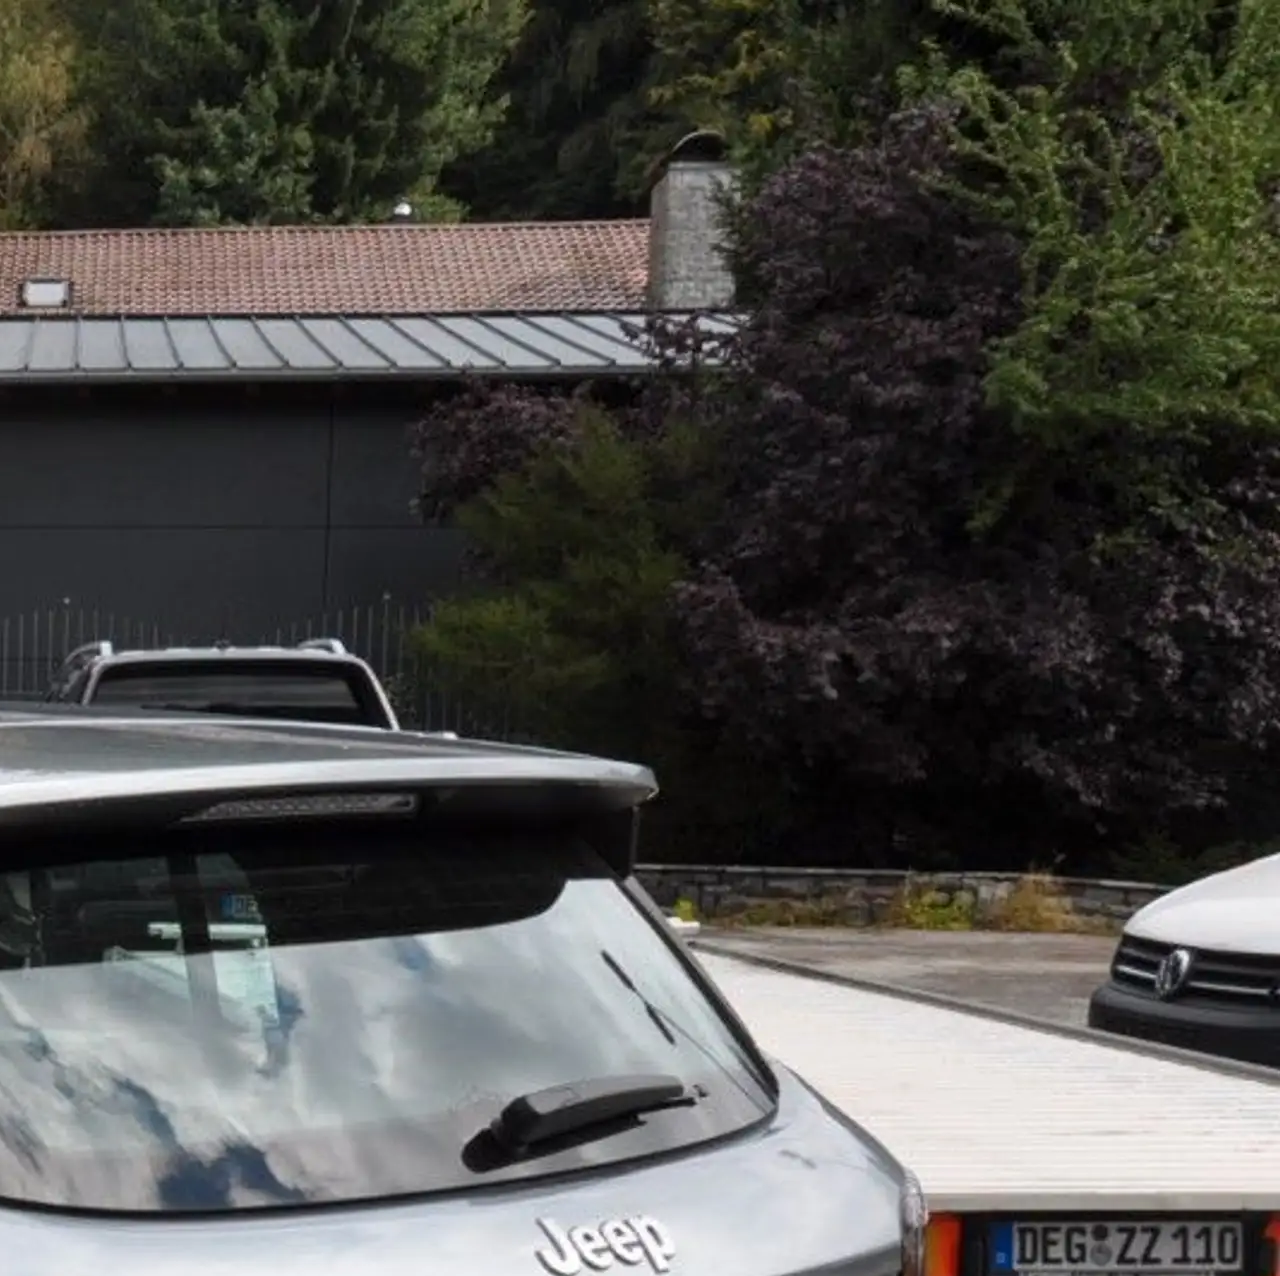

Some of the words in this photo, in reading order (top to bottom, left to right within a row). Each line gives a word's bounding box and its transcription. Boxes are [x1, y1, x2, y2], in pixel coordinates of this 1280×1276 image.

[1017, 1226, 1088, 1265] DEG
[1116, 1226, 1162, 1266] ZZ
[1171, 1226, 1238, 1265] 110
